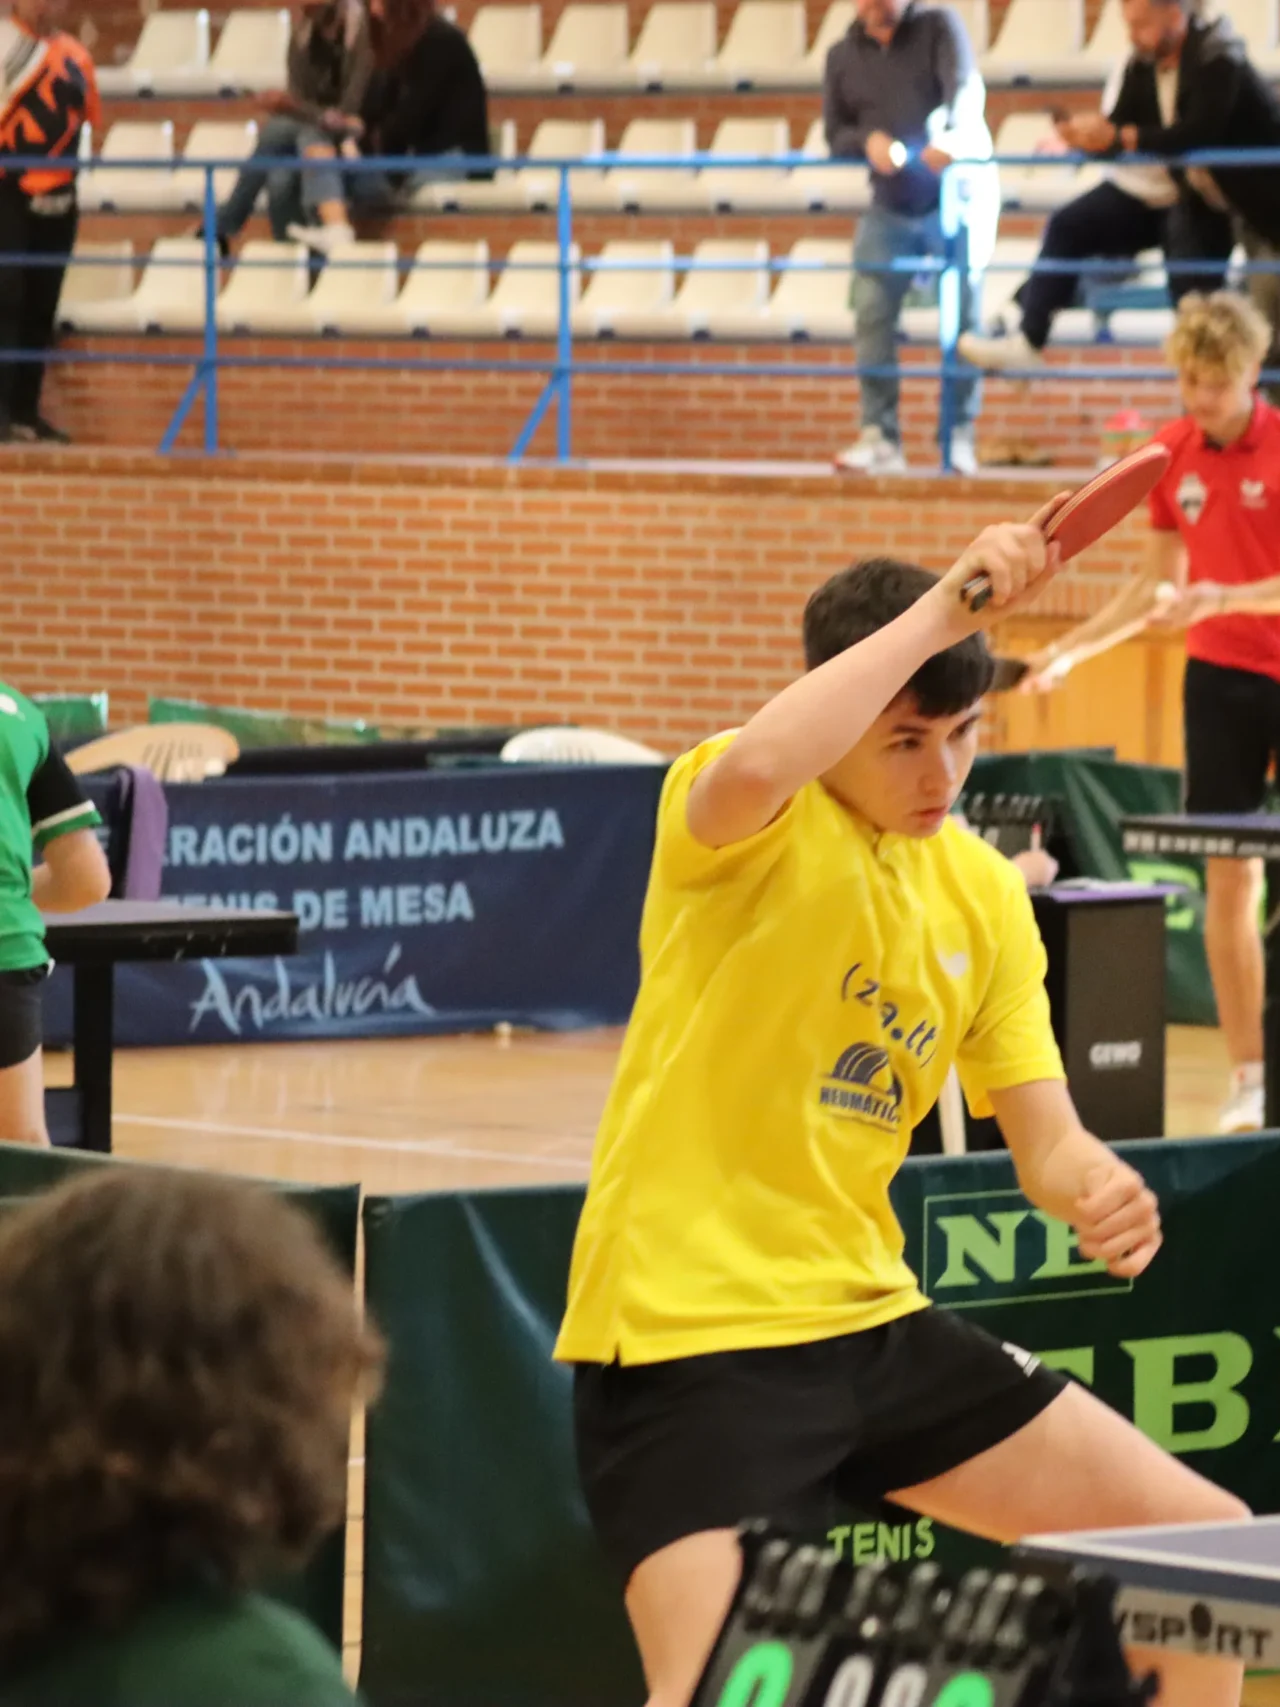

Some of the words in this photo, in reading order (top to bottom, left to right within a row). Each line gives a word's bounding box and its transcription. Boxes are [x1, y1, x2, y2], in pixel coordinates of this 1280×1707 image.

[163, 812, 333, 867] RACIÓN
[343, 807, 565, 862] ANDALUZA
[293, 888, 349, 931] DE
[359, 881, 475, 929] MESA
[189, 942, 436, 1035] Andalucía
[826, 1517, 936, 1566] TENIS
